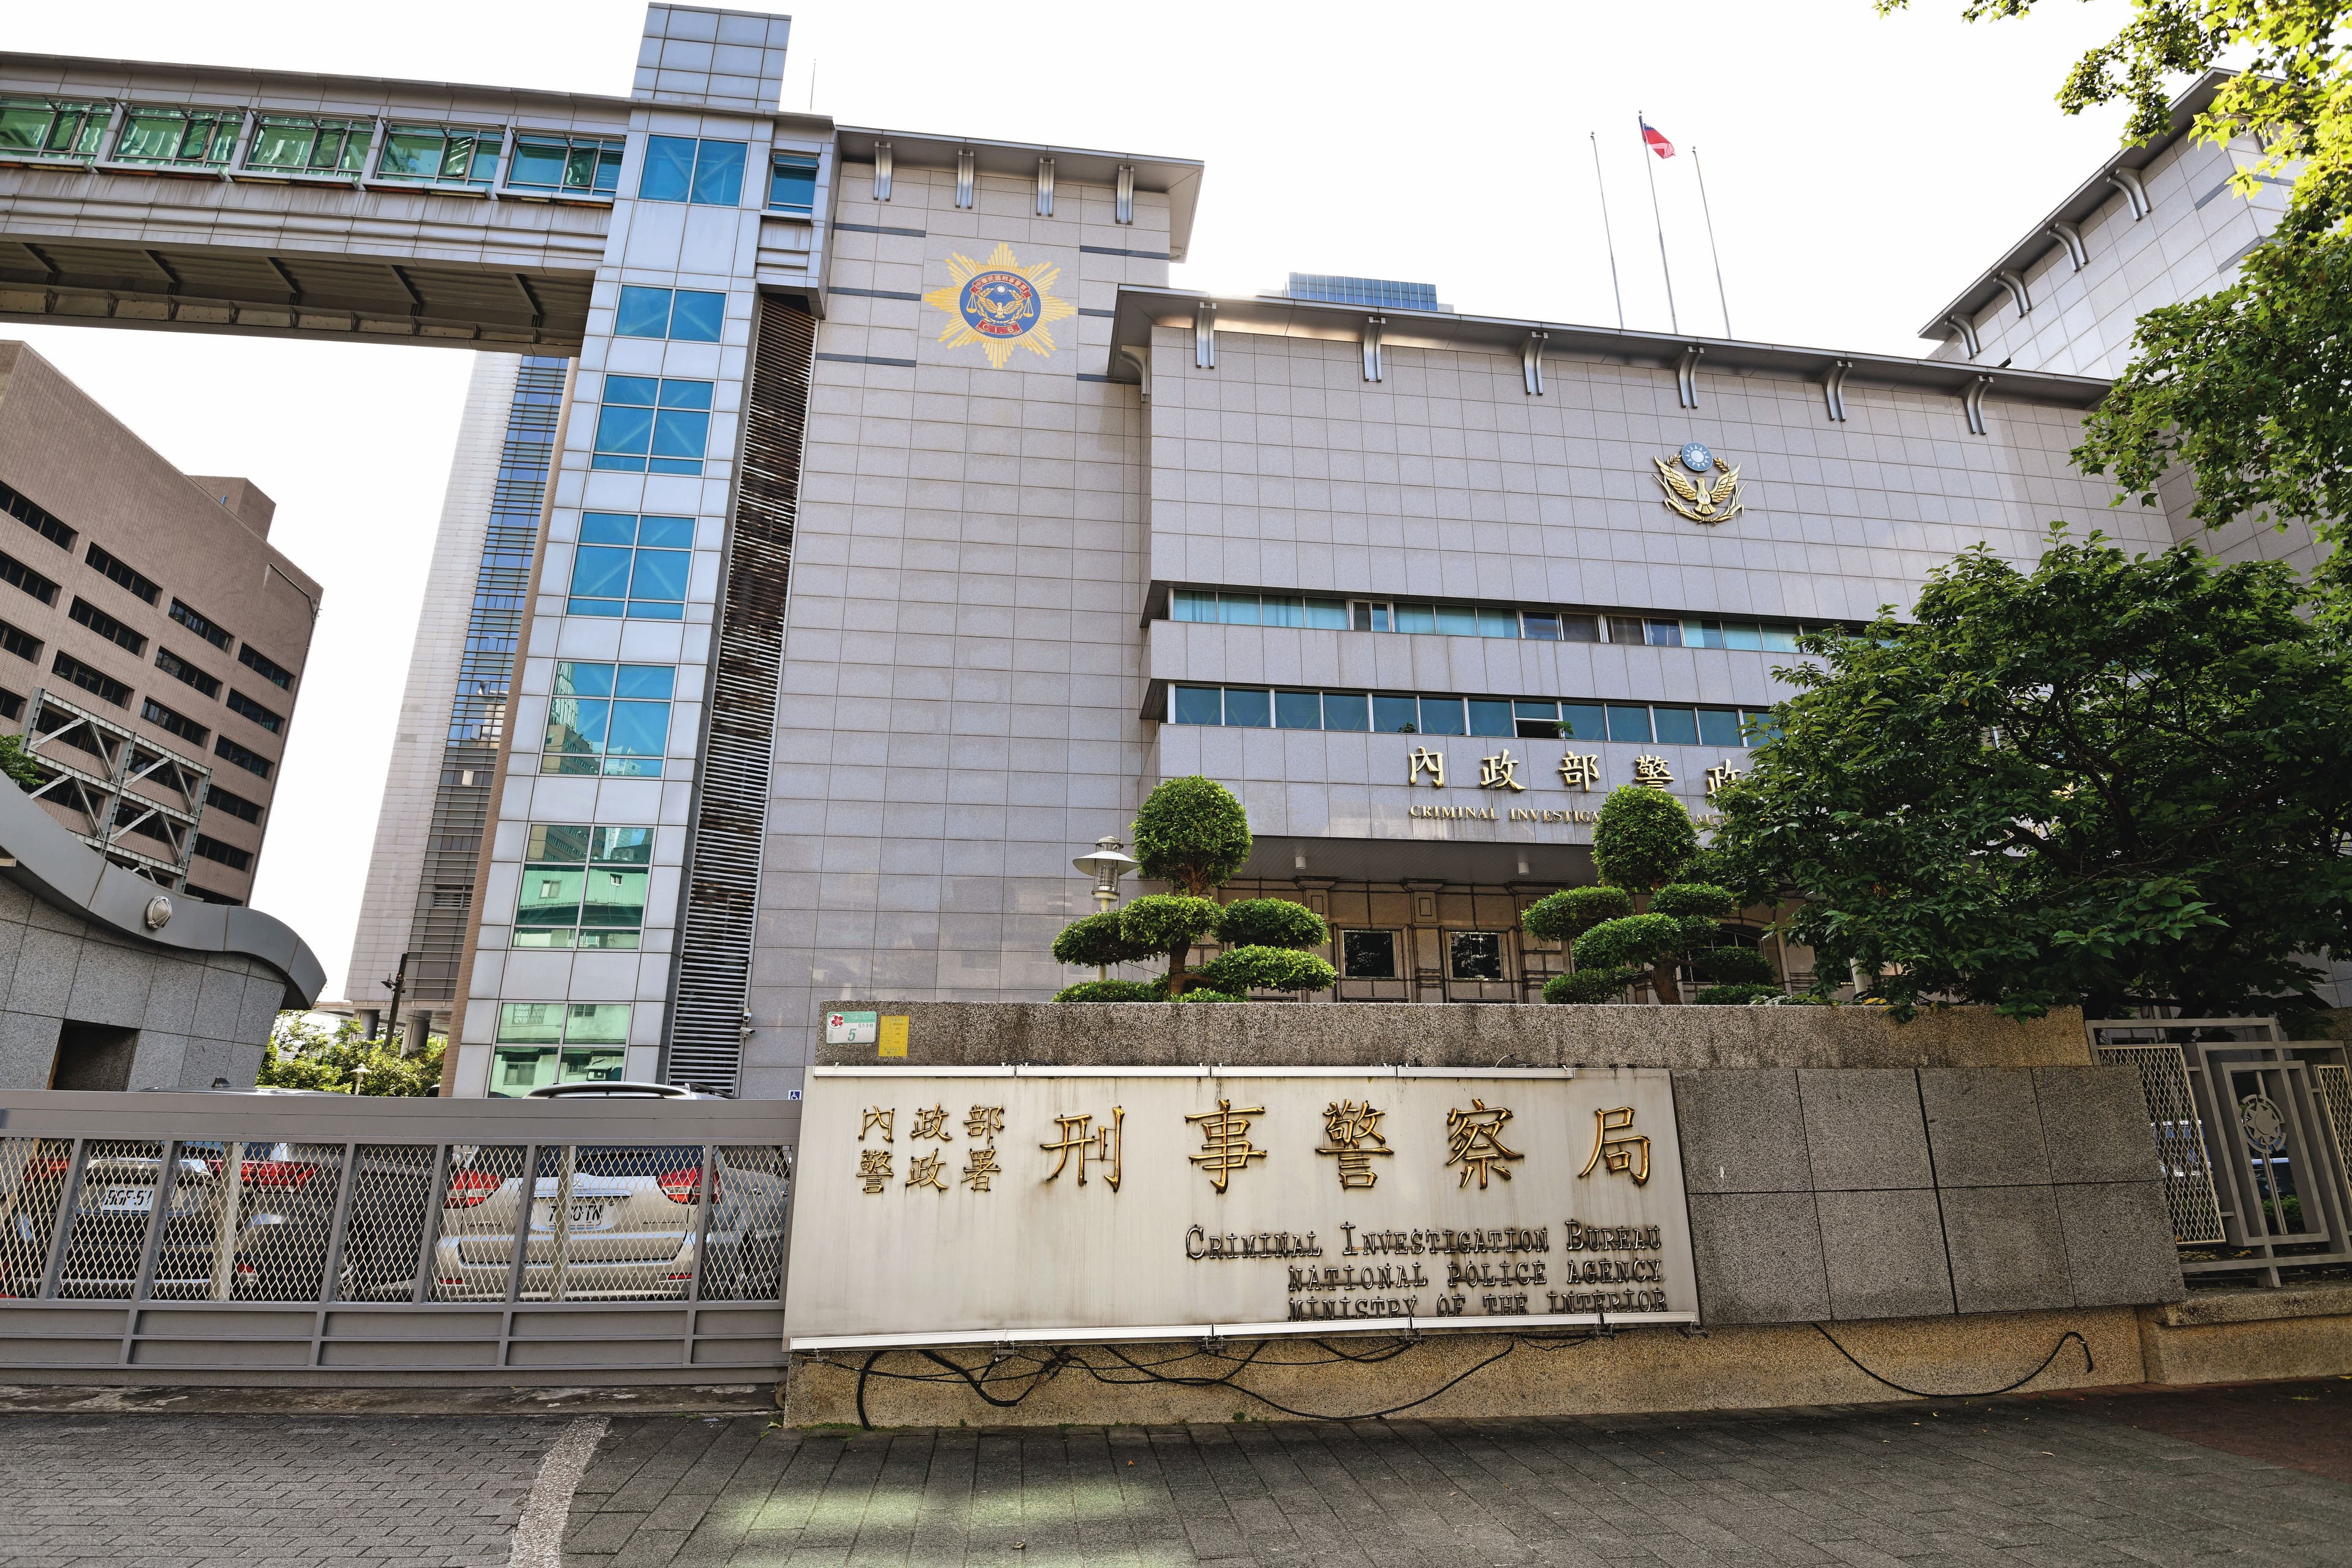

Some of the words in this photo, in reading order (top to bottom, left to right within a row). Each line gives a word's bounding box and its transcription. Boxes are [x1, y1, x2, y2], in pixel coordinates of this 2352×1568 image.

[1409, 805, 1499, 820] CRIMINAL
[1510, 808, 1601, 823] INVESTIGA
[847, 1028, 856, 1041] 5
[858, 1102, 1005, 1145] 內政部
[1039, 1098, 1651, 1193] 刑事警察局
[856, 1146, 1001, 1194] 警政署
[1185, 1224, 1322, 1259] CRIMINAL
[1340, 1221, 1549, 1256] INVESTIGATION
[1565, 1219, 1660, 1251] BUREAU
[1288, 1263, 1428, 1291] NATIONAL
[1447, 1261, 1547, 1286] POLICE
[1566, 1258, 1663, 1283] AGENCY
[1288, 1295, 1417, 1321] MINISTRY
[1436, 1294, 1466, 1317] OF
[1483, 1292, 1529, 1316] THE
[1546, 1287, 1668, 1314] INTERIOR
